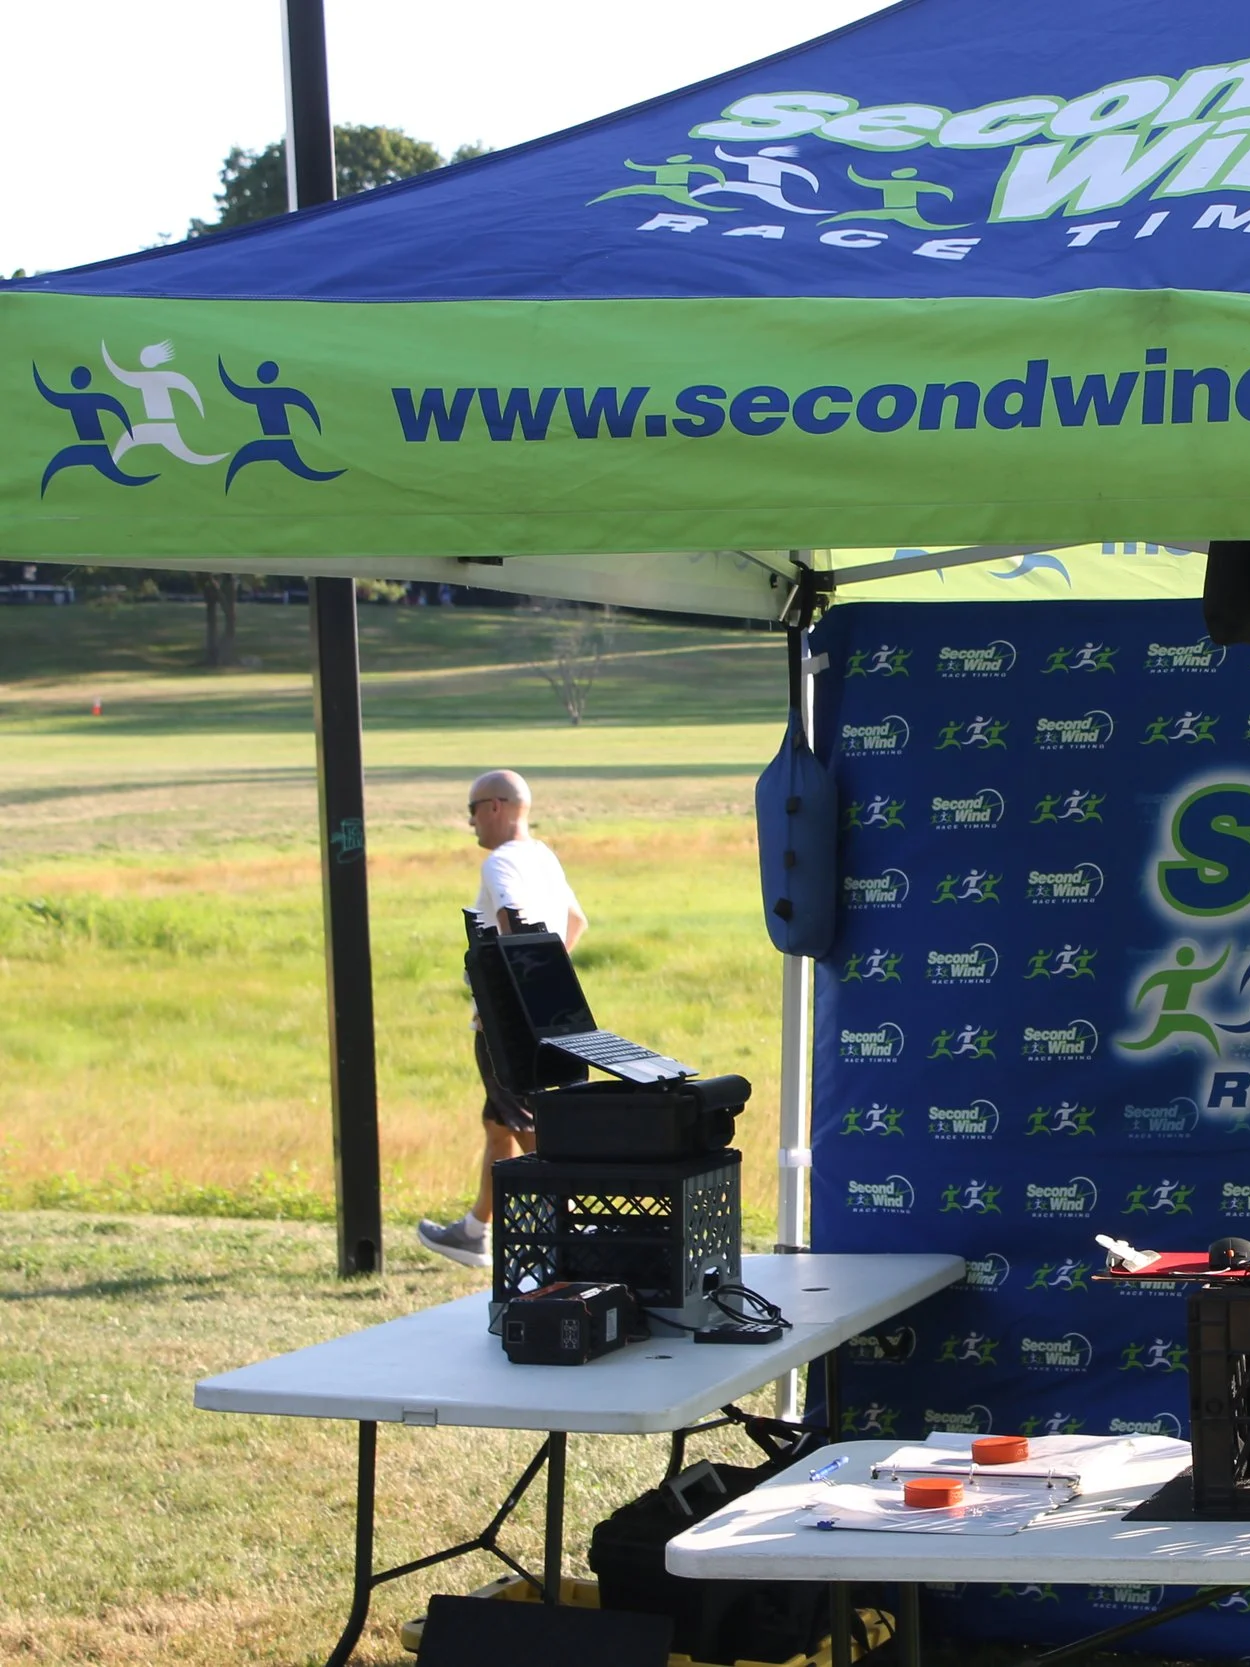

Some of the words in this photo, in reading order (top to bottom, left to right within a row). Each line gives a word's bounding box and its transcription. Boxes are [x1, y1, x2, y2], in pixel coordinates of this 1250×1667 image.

[637, 213, 981, 260] RACE
[939, 647, 996, 659] Second
[1147, 642, 1206, 656] Second
[964, 659, 1002, 671] Wind
[1173, 654, 1212, 666] Wind
[841, 722, 890, 738] Second
[1036, 717, 1093, 731] Second
[864, 735, 897, 749] Wind
[1062, 729, 1100, 742] Wind
[931, 796, 984, 810] Second
[956, 808, 991, 822] Wind
[843, 875, 891, 890] Second
[1028, 870, 1083, 884] Second
[865, 888, 897, 902] Wind
[1053, 883, 1090, 896] Wind
[927, 950, 979, 964] Second
[951, 963, 986, 977] Wind
[840, 1029, 886, 1043] Second
[1023, 1027, 1077, 1041] Second
[861, 1043, 892, 1056] Wind
[1048, 1040, 1085, 1054] Wind
[929, 1106, 979, 1120] Second
[952, 1120, 987, 1133] Wind
[848, 1180, 894, 1194] Second
[1026, 1184, 1078, 1197] Second
[871, 1194, 903, 1207] Wind
[1050, 1197, 1085, 1210] Wind
[1021, 1338, 1072, 1352] Second
[1045, 1352, 1080, 1365] Wind
